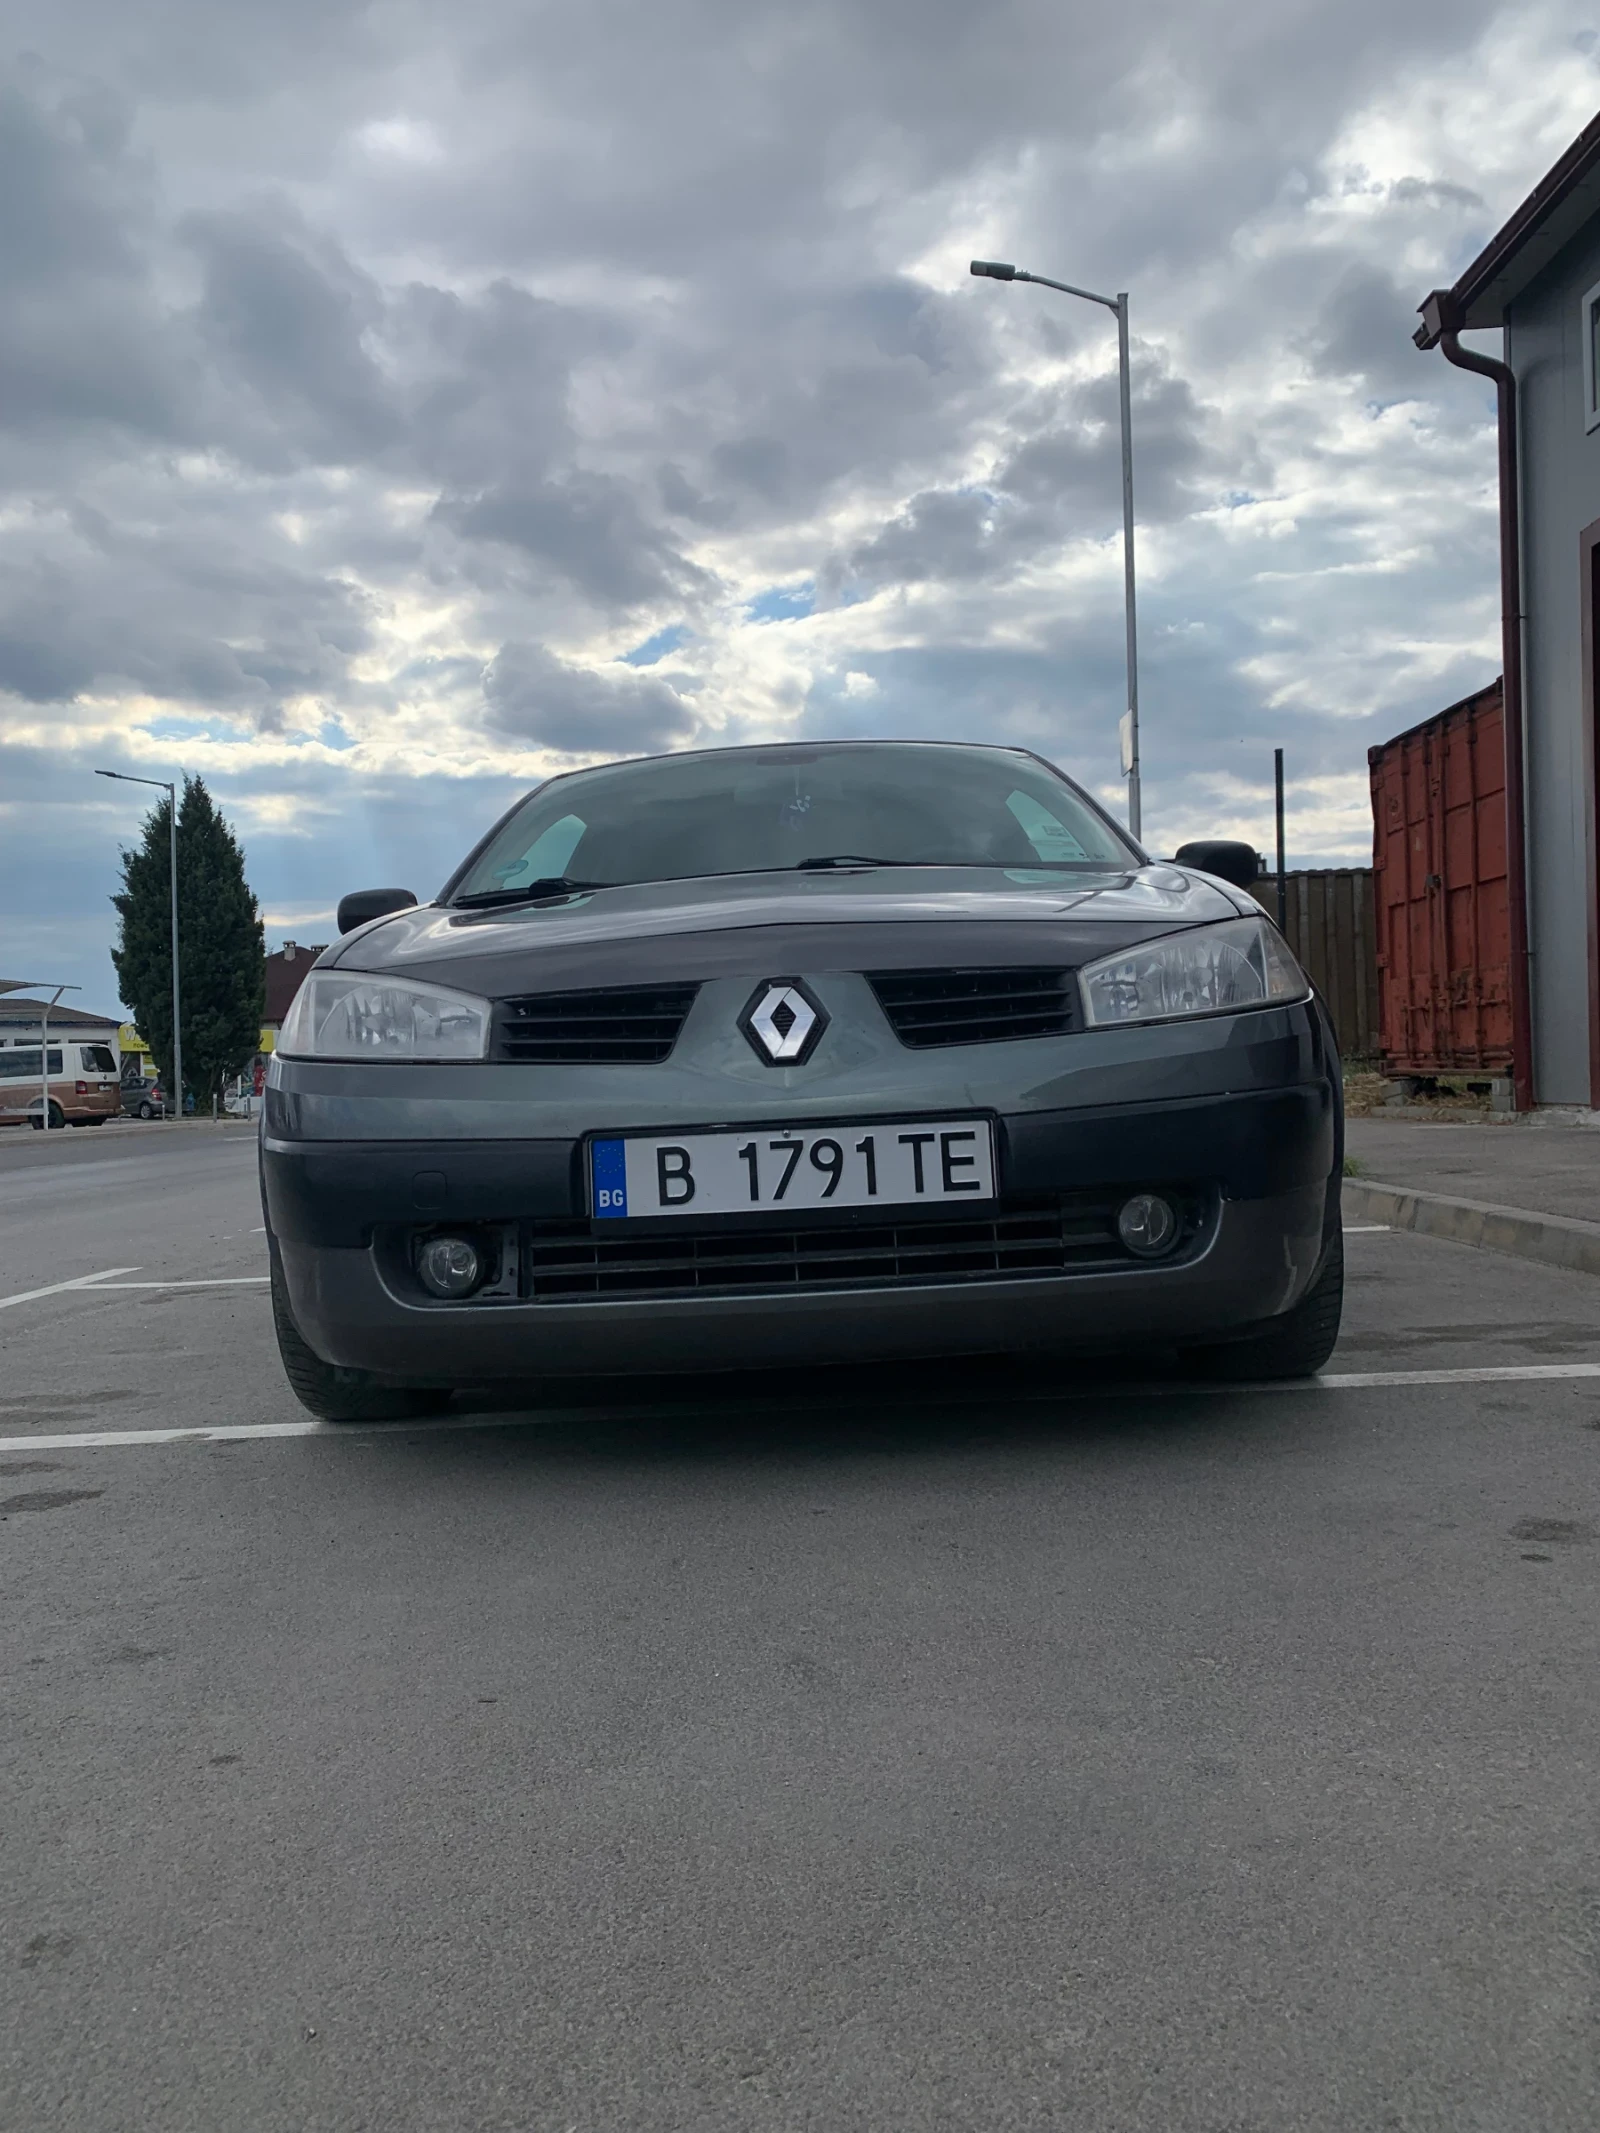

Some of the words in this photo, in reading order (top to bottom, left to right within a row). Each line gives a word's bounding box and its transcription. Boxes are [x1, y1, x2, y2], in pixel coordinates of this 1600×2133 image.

[656, 1146, 696, 1206] B
[738, 1136, 877, 1201] 1791
[898, 1131, 981, 1193] TE
[599, 1189, 624, 1208] BG
